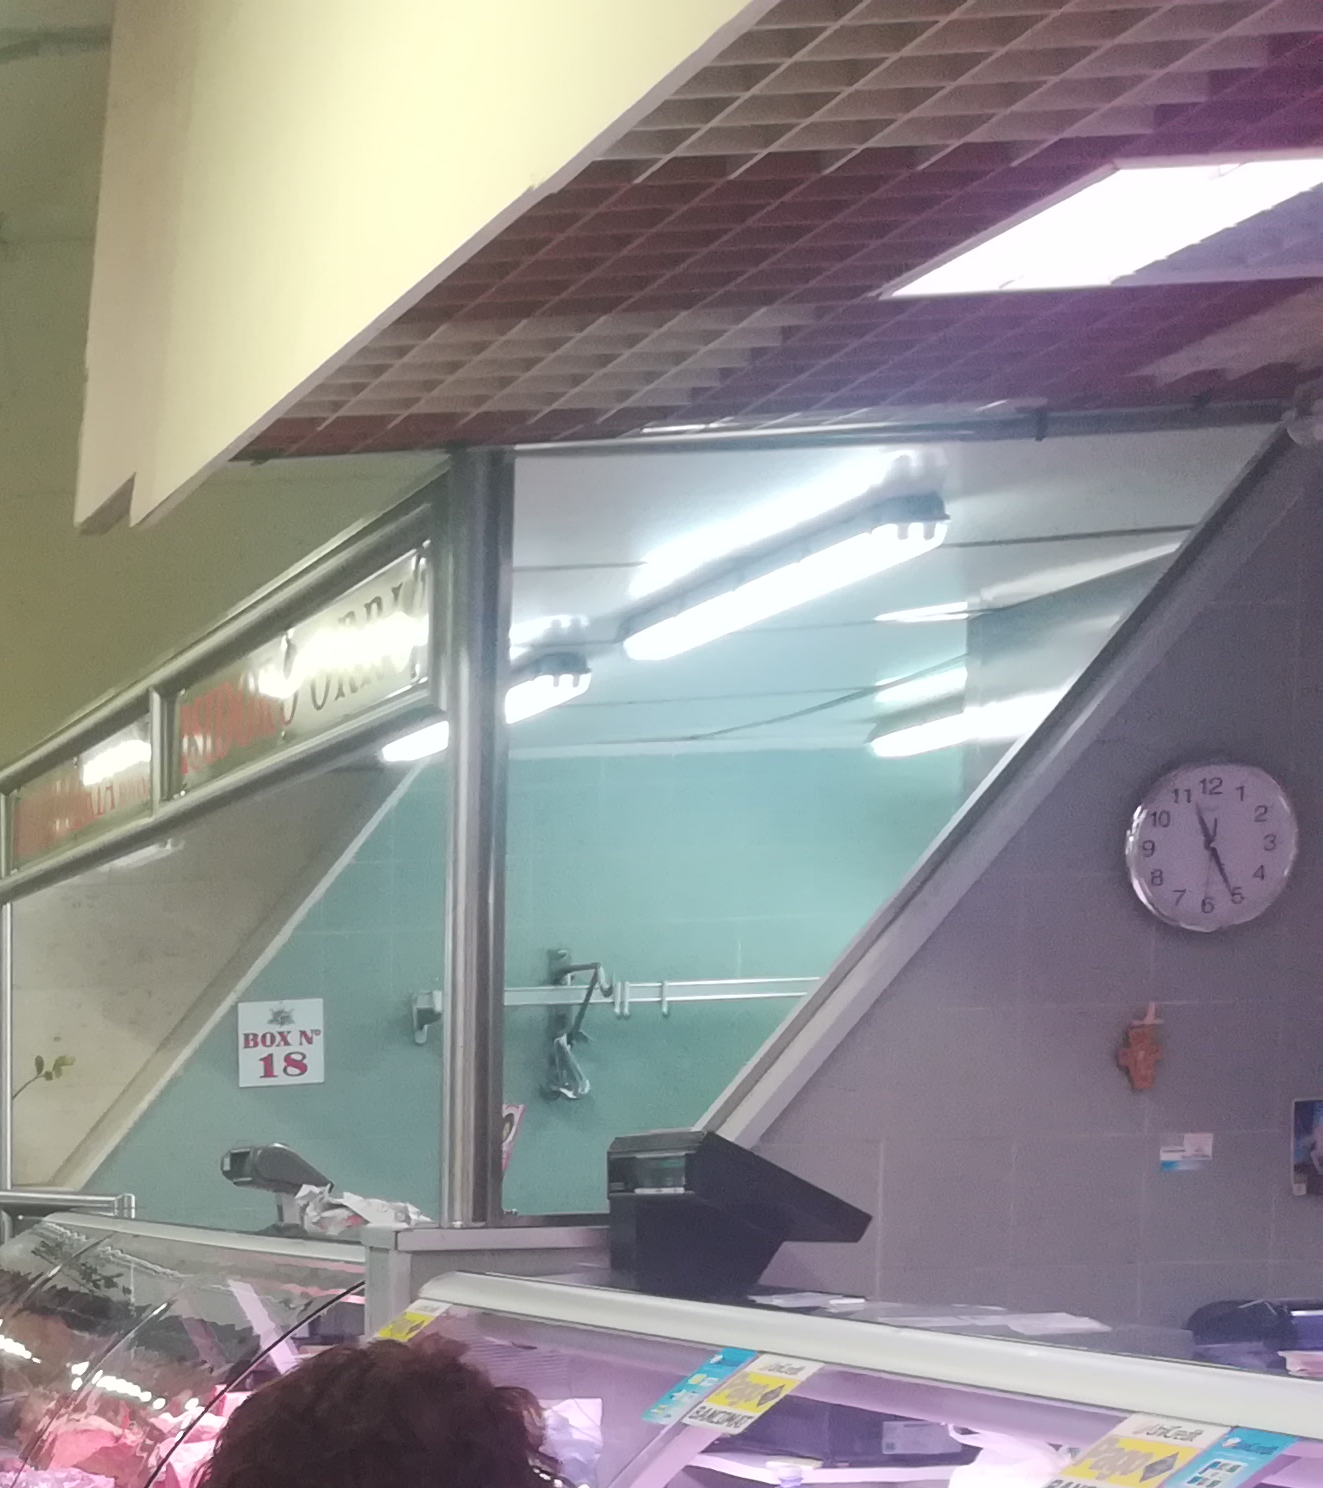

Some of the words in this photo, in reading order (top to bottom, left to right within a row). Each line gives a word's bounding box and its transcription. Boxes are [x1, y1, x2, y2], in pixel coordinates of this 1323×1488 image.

[1199, 776, 1224, 796] 12
[1235, 785, 1246, 801] 1
[1171, 788, 1193, 804] 11
[1150, 809, 1171, 828] 10
[1254, 804, 1268, 823] 2
[1141, 839, 1156, 858] 9
[1262, 833, 1277, 852] 3
[1150, 868, 1164, 887] 8
[1252, 864, 1265, 881] 4
[1172, 888, 1187, 906] 7
[1200, 896, 1215, 914] 6
[1230, 886, 1246, 905] 5
[242, 1030, 293, 1050] BOX
[258, 1051, 308, 1079] 18
[688, 1405, 756, 1429] BANCOMAT
